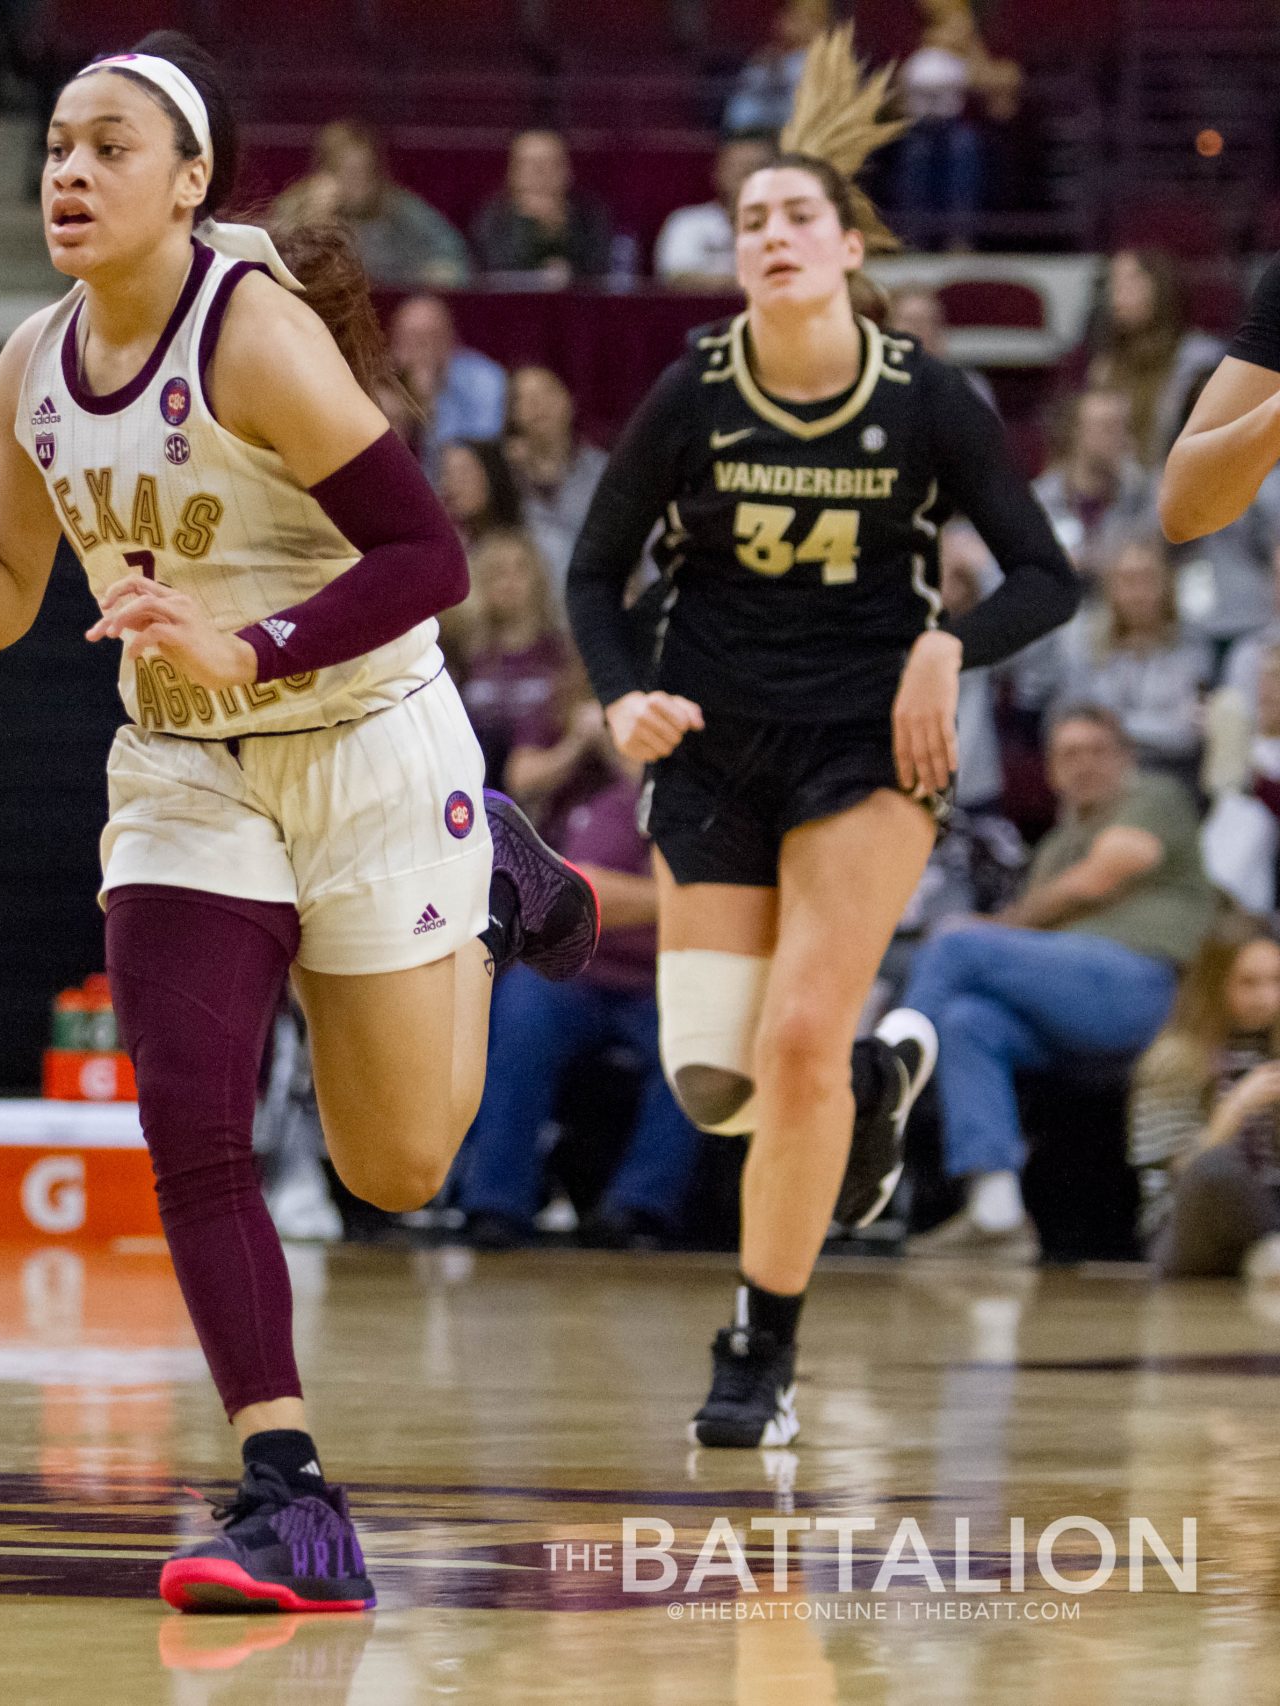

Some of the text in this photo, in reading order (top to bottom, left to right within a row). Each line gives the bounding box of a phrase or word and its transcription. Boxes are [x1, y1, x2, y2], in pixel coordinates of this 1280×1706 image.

[31, 413, 62, 425] adidas
[38, 444, 52, 459] 41
[166, 435, 189, 463] SEC
[713, 461, 899, 499] VANDERBILT
[53, 467, 224, 560] EXAS
[733, 501, 862, 586] 34
[258, 619, 287, 648] adidas
[413, 916, 447, 935] adidas
[22, 1154, 88, 1234] G
